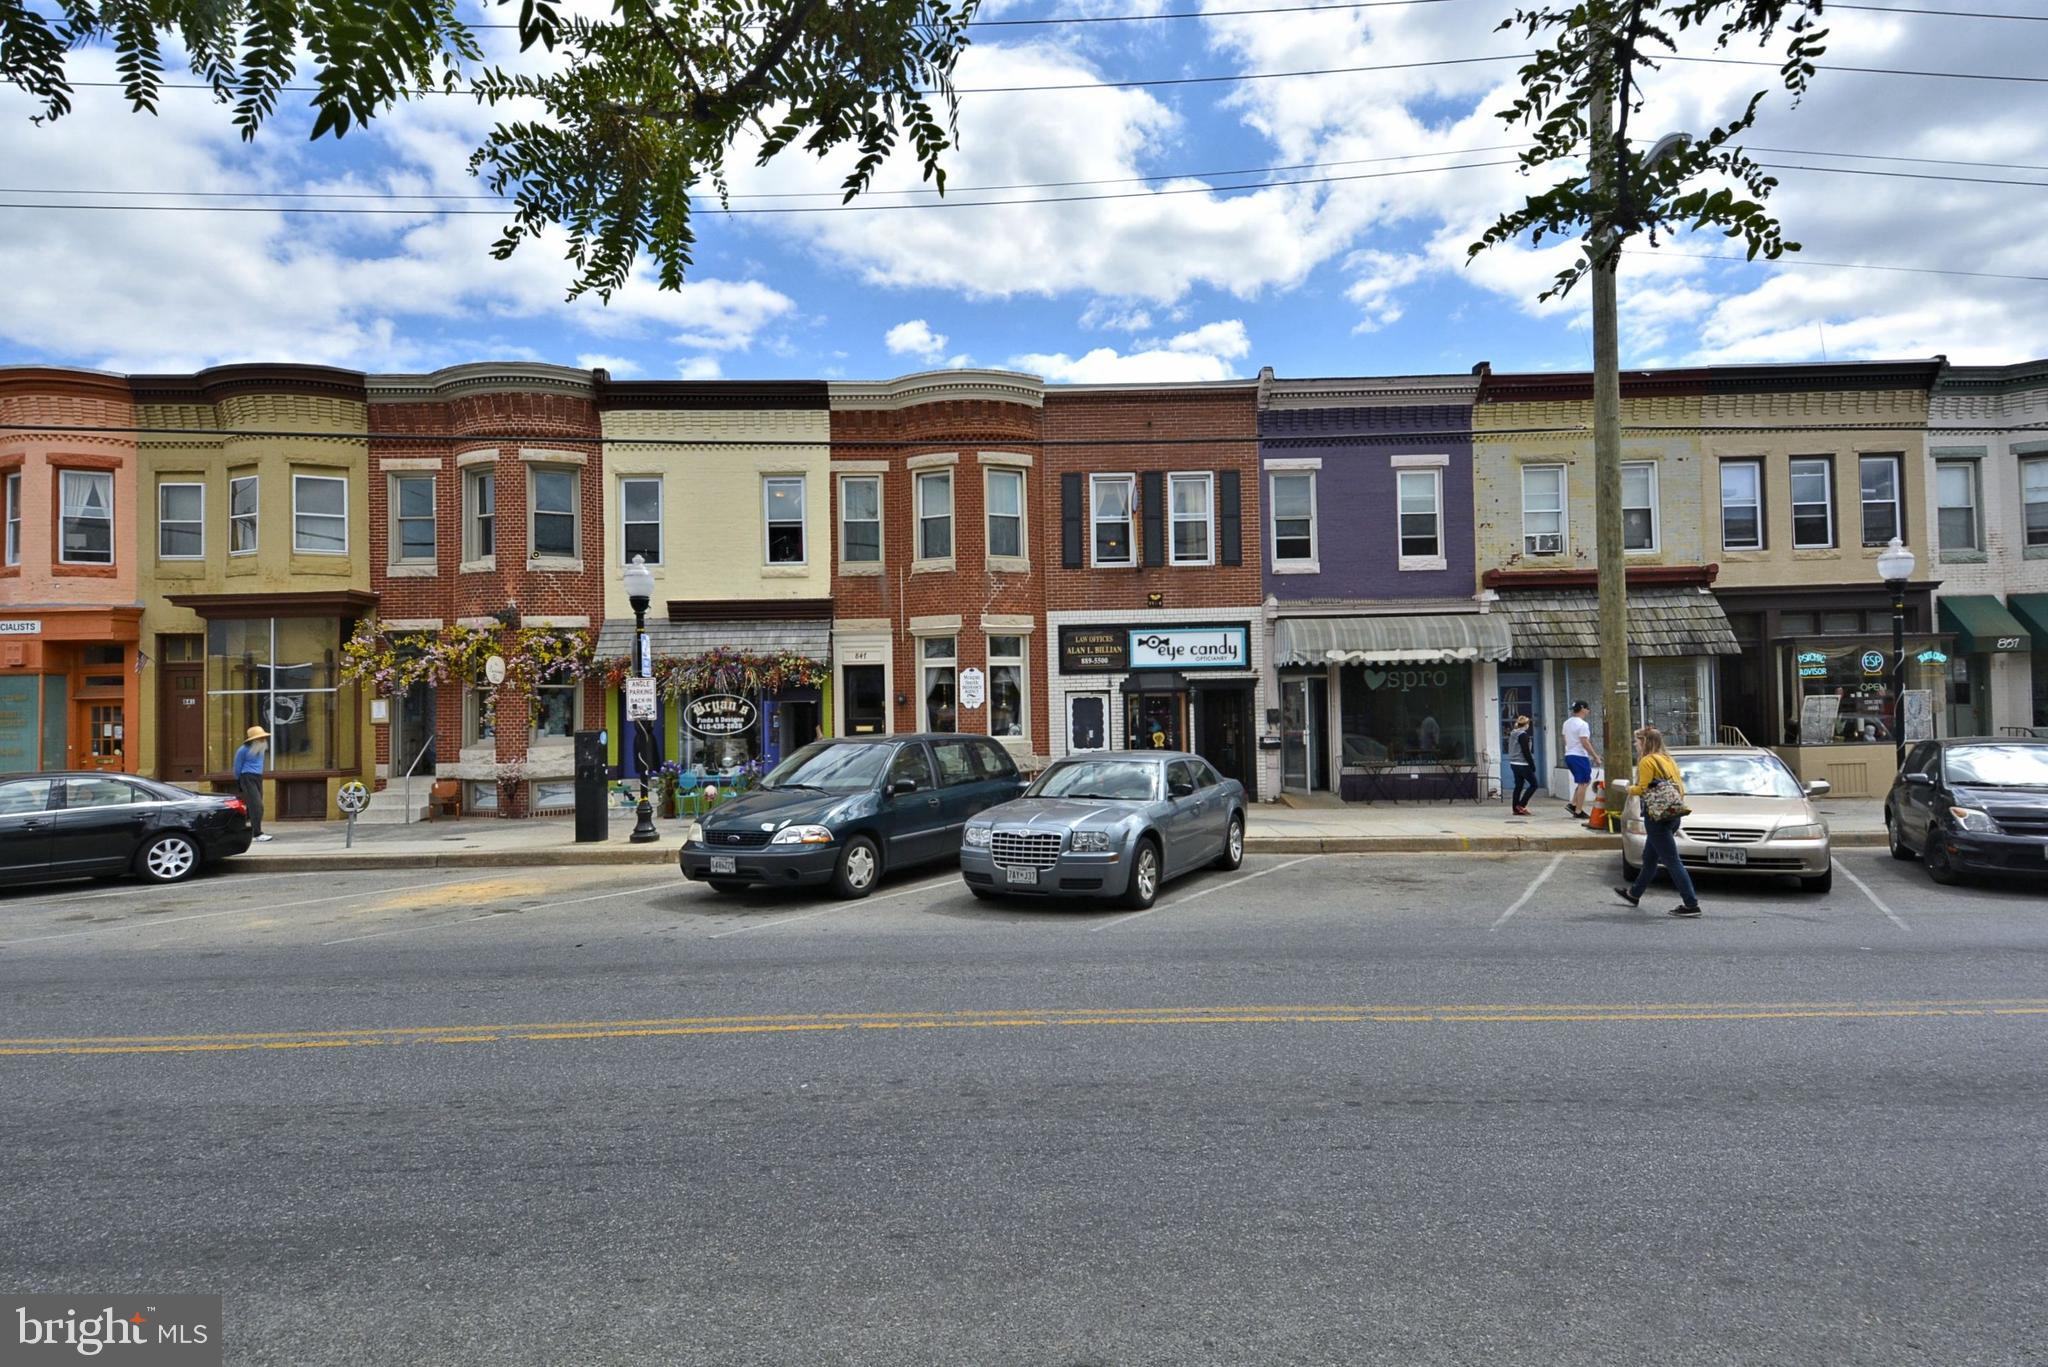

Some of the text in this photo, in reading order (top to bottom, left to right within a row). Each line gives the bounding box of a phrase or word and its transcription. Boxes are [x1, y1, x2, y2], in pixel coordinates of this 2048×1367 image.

[1075, 635, 1114, 643] LAW OFFICES
[1997, 637, 2020, 649] 857
[1158, 633, 1238, 661] eye candy
[1864, 655, 1882, 667] ESP
[1799, 667, 1827, 676] ADVISOR
[1387, 669, 1448, 692] spro
[1860, 683, 1887, 692] OPEN
[690, 699, 750, 716] Bryan's
